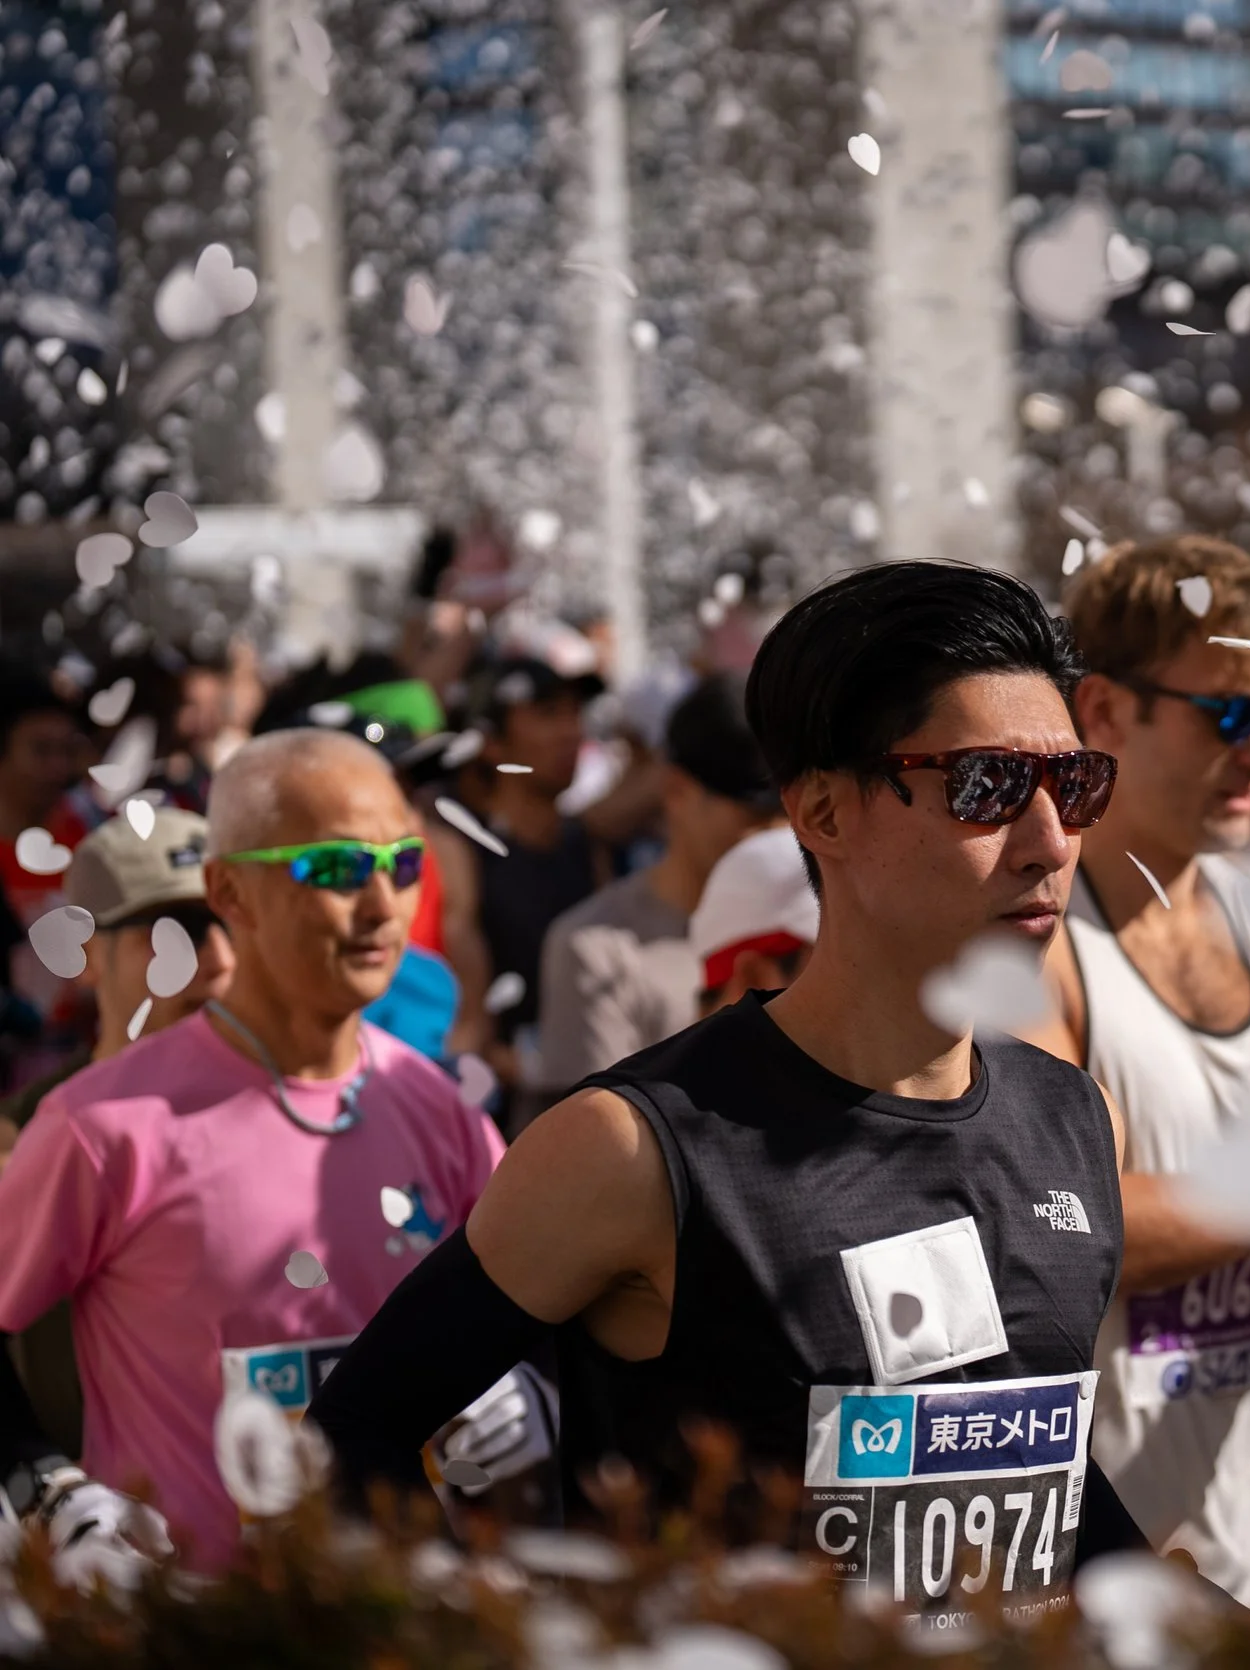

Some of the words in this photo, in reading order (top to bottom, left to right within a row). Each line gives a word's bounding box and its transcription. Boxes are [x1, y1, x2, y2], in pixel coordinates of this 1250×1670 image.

[1033, 1204, 1074, 1218] NORTH
[1047, 1190, 1071, 1204] THE
[1049, 1217, 1078, 1231] FACE
[927, 1405, 1072, 1454] 東京メトロ
[815, 1506, 858, 1556] C
[893, 1488, 1058, 1601] 10974
